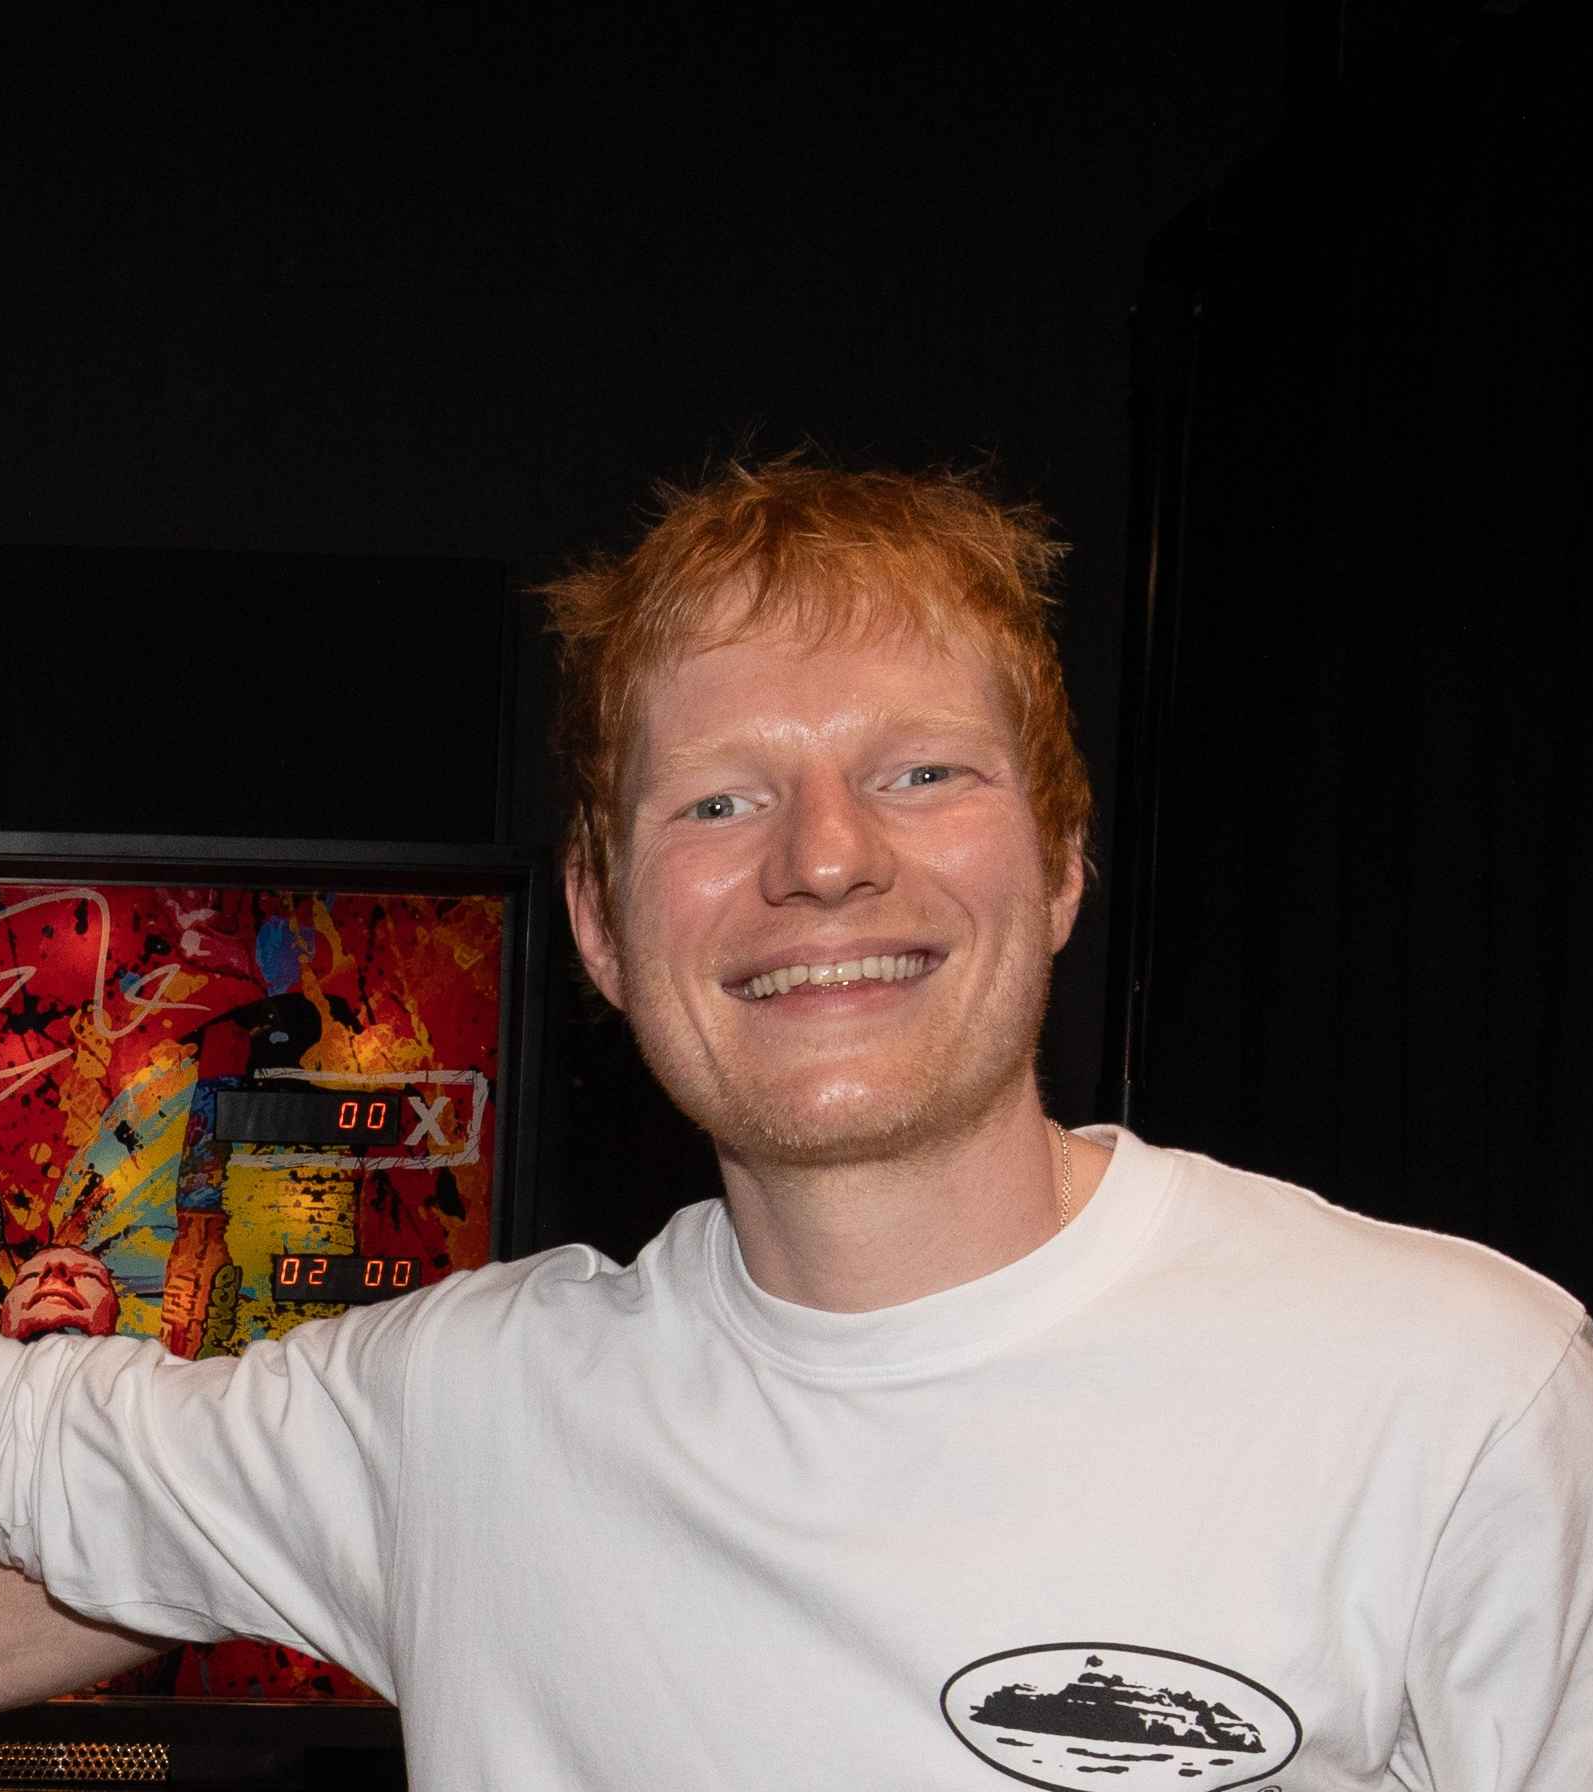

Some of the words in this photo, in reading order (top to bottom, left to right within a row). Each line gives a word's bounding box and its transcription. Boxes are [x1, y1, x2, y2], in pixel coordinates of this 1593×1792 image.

[339, 1102, 386, 1129] 00
[281, 1258, 327, 1285] 02
[364, 1260, 411, 1287] 00
